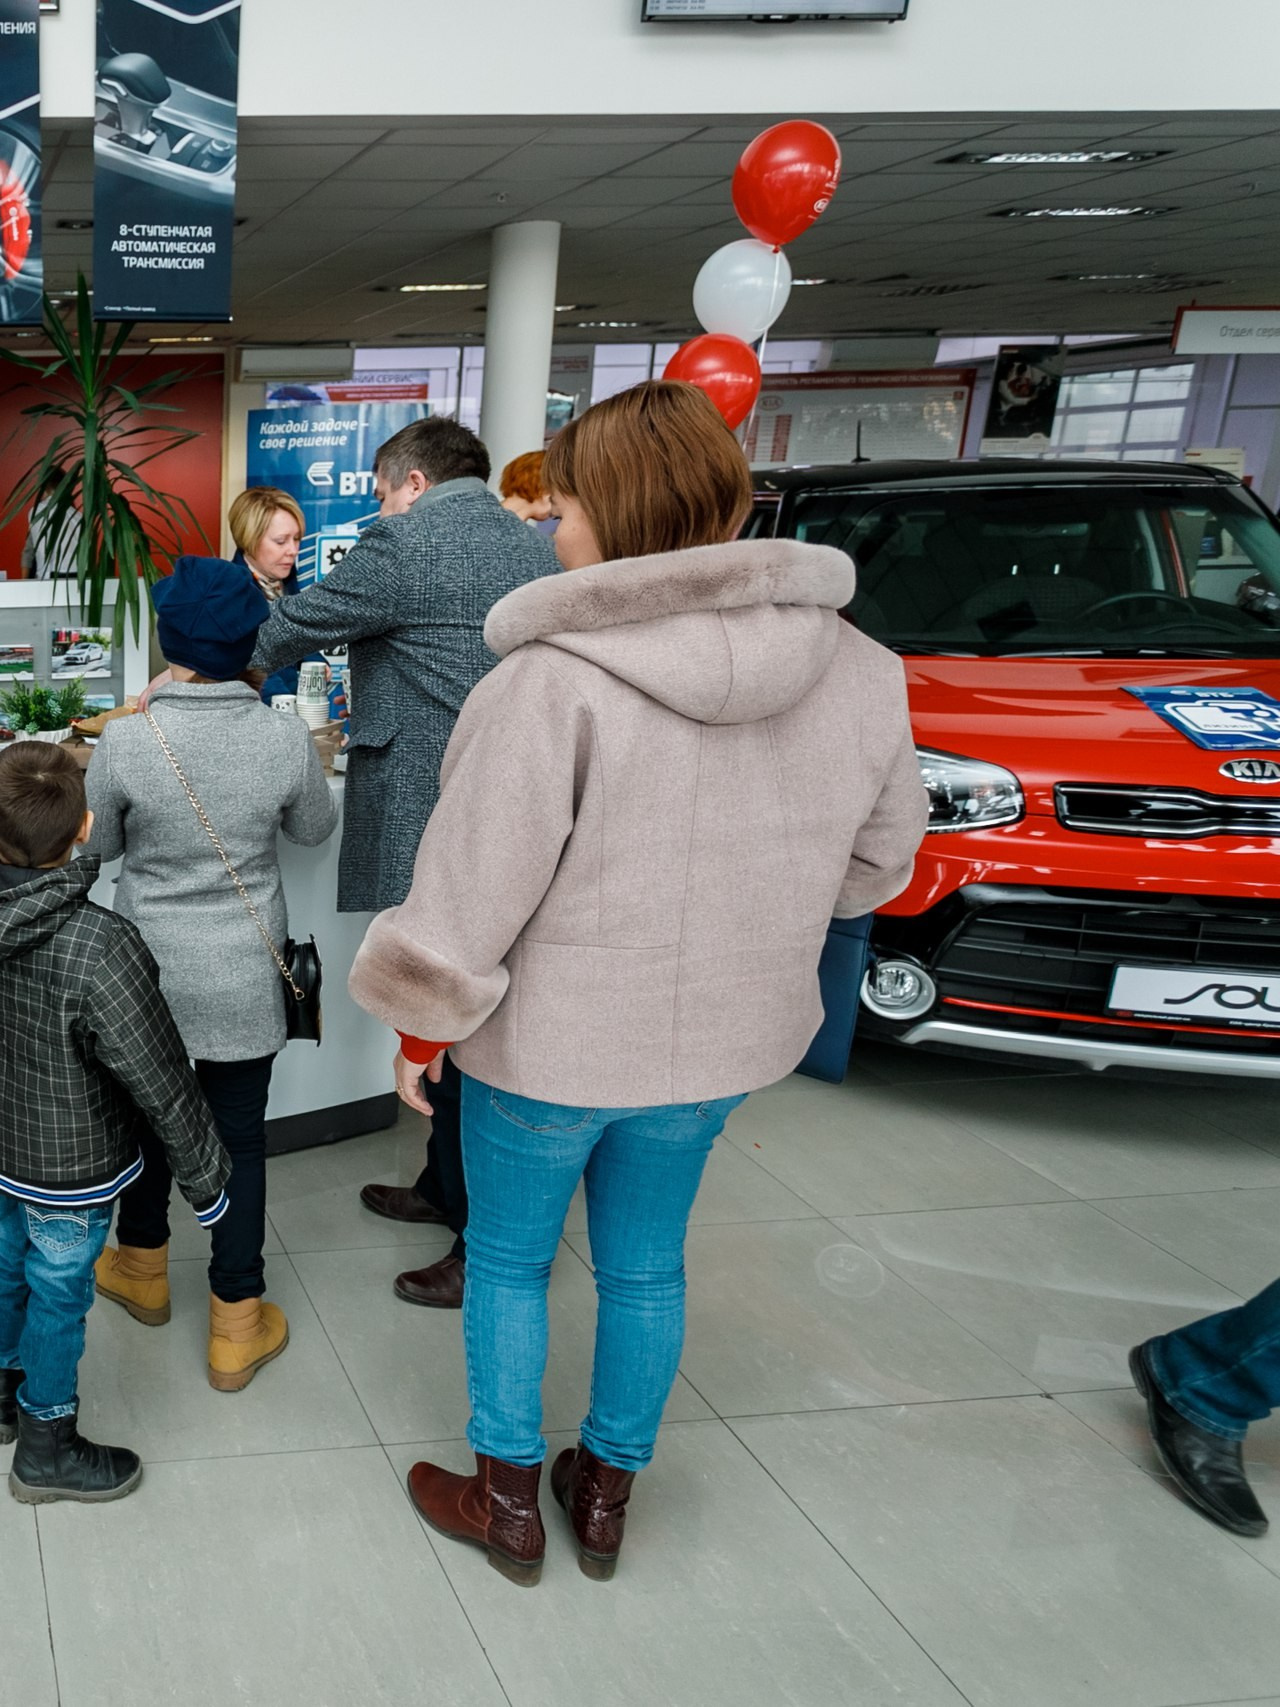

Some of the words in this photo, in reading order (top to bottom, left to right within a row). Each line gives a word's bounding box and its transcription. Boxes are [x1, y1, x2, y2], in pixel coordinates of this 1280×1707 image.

[120, 224, 213, 238] 8-СТУПЕНЧАТАЯ
[110, 240, 217, 254] АВТОМАТИЧЕСКАЯ
[122, 256, 205, 270] ТРАНСМИССИЯ
[260, 420, 309, 435] Каждой
[310, 418, 358, 432] задаче
[259, 436, 286, 450] свое
[287, 434, 348, 451] решение
[339, 470, 377, 496] ВТ
[1230, 761, 1280, 777] KIA
